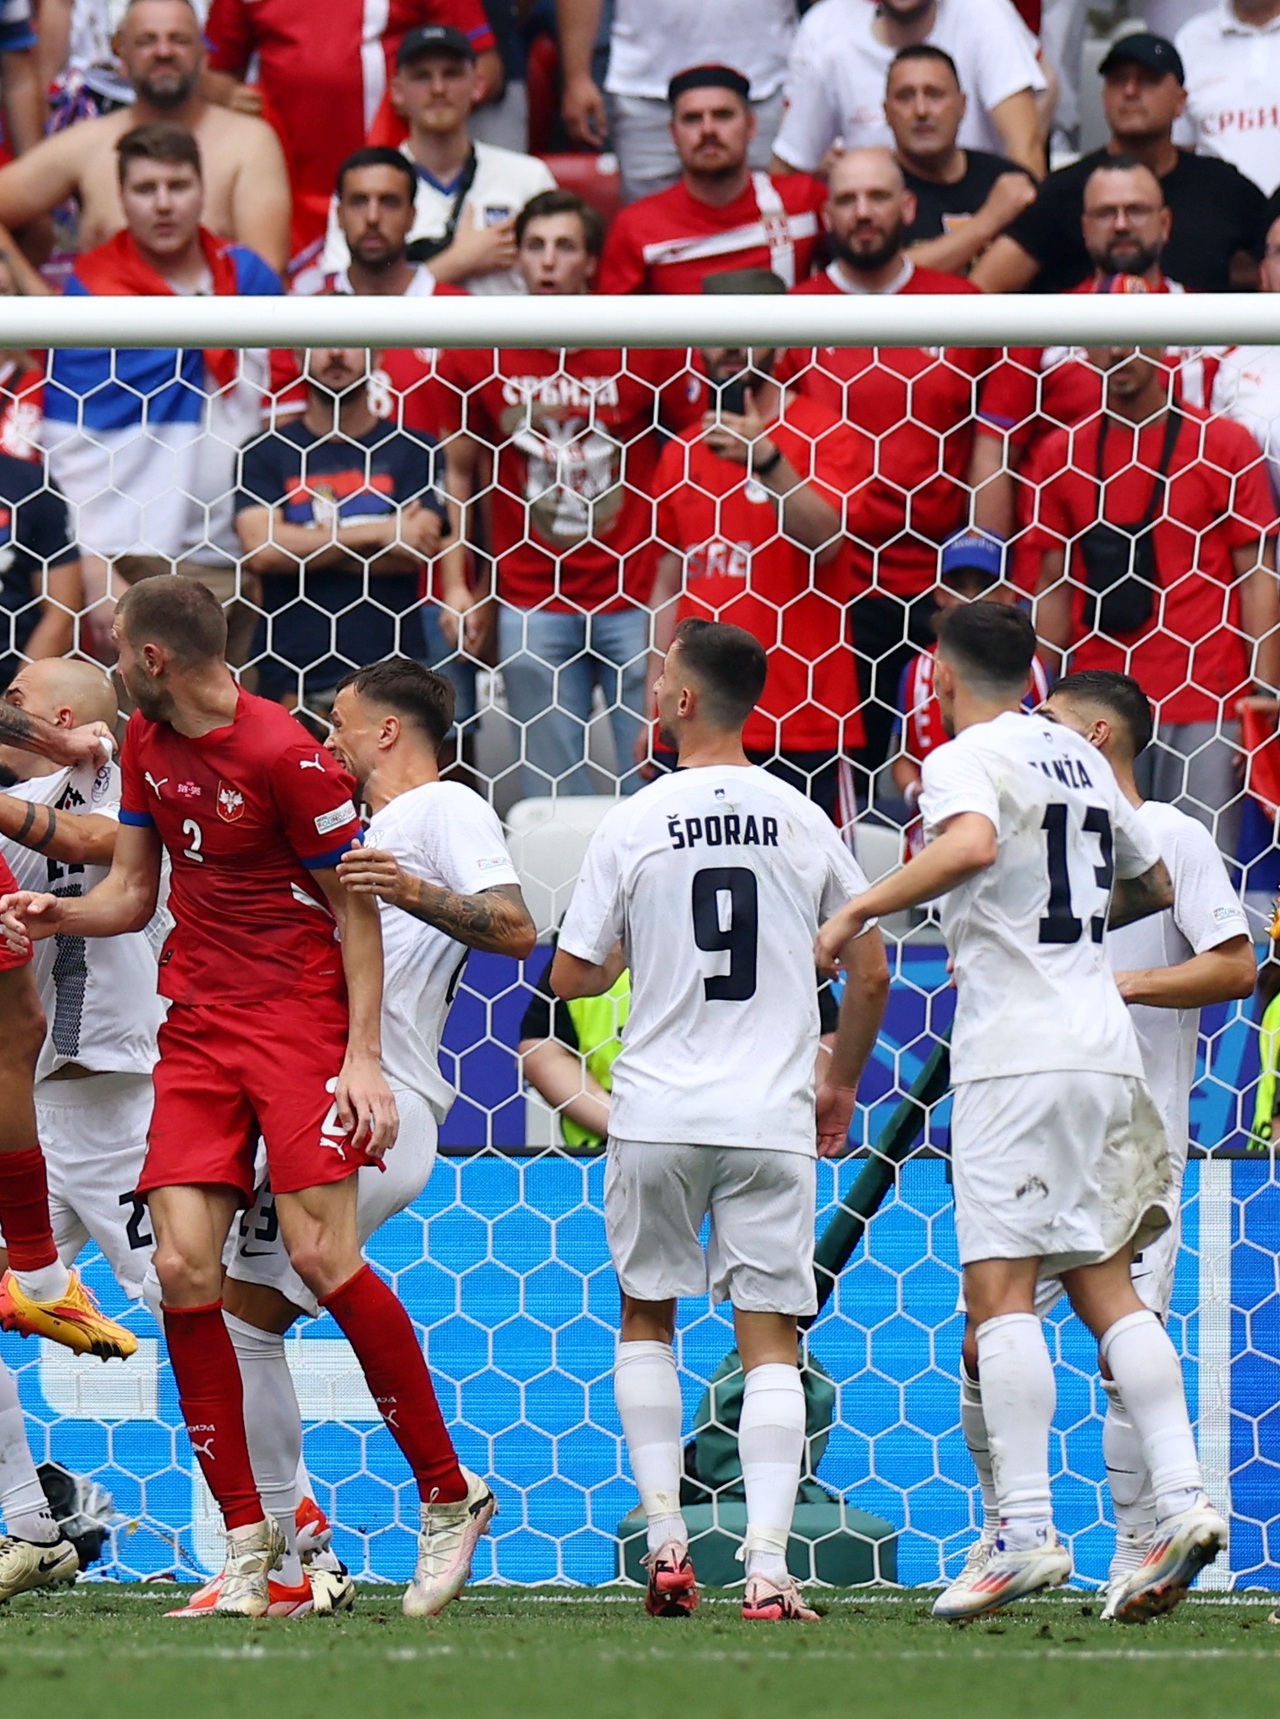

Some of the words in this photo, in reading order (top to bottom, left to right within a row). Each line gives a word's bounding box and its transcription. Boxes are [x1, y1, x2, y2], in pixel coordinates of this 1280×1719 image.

[182, 818, 204, 863] 2
[666, 813, 779, 850] ŠPORAR
[1038, 803, 1114, 945] 13
[692, 866, 758, 1003] 9
